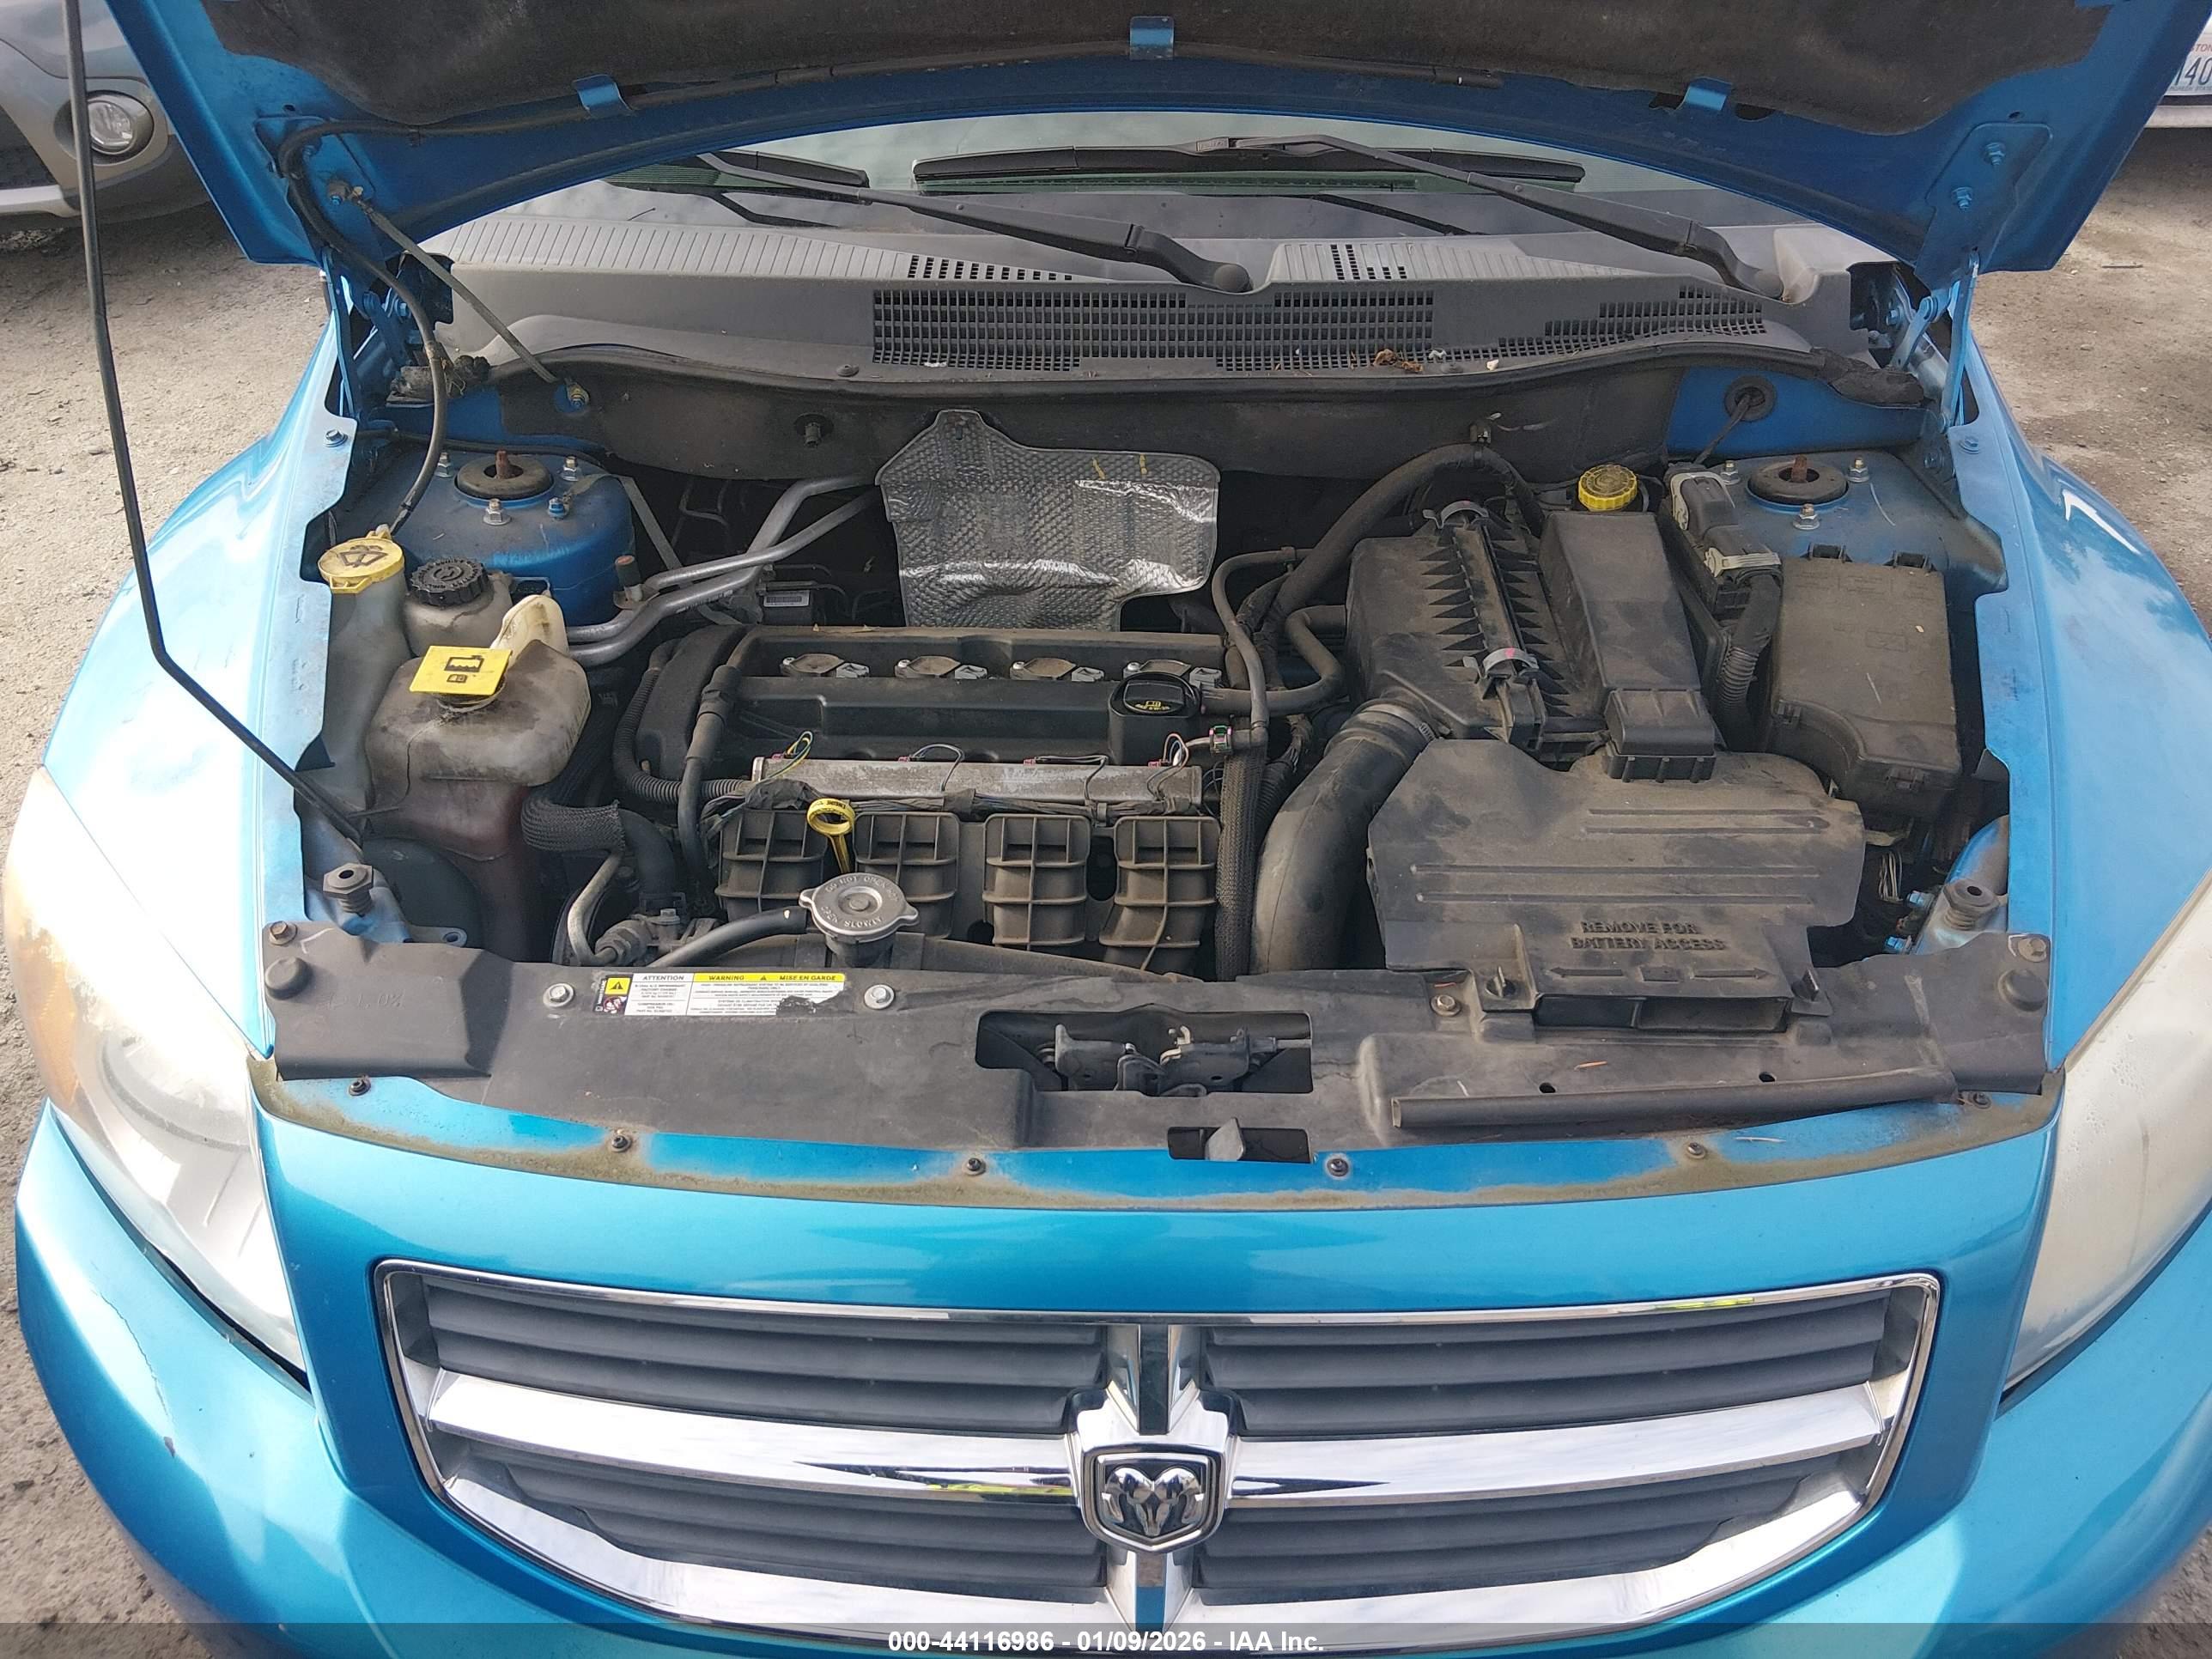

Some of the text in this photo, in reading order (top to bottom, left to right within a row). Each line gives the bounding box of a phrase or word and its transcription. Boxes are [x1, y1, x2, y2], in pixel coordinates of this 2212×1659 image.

[825, 883, 839, 893] DO
[840, 876, 859, 884] NOT
[864, 876, 886, 889] OPEN
[821, 905, 883, 928] OPEN SLOWLY
[1581, 920, 1700, 935] REMOVE FOR
[1570, 936, 1726, 951] BATTERY ACCESS
